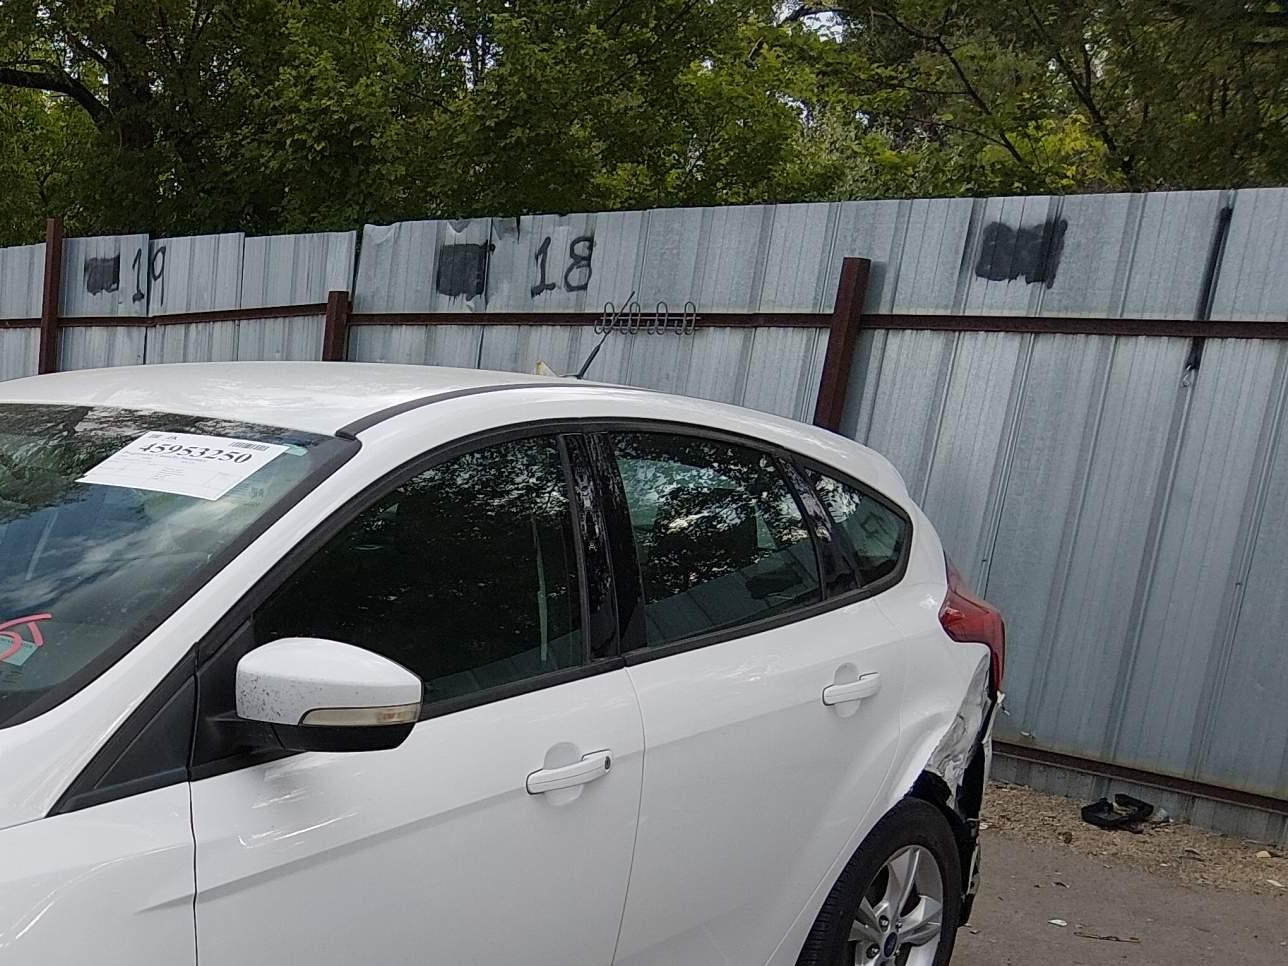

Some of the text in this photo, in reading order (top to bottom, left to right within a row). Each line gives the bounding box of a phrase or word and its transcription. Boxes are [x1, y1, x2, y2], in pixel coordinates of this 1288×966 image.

[132, 247, 167, 307] 19
[531, 236, 595, 298] 18
[139, 442, 252, 464] 45953250
